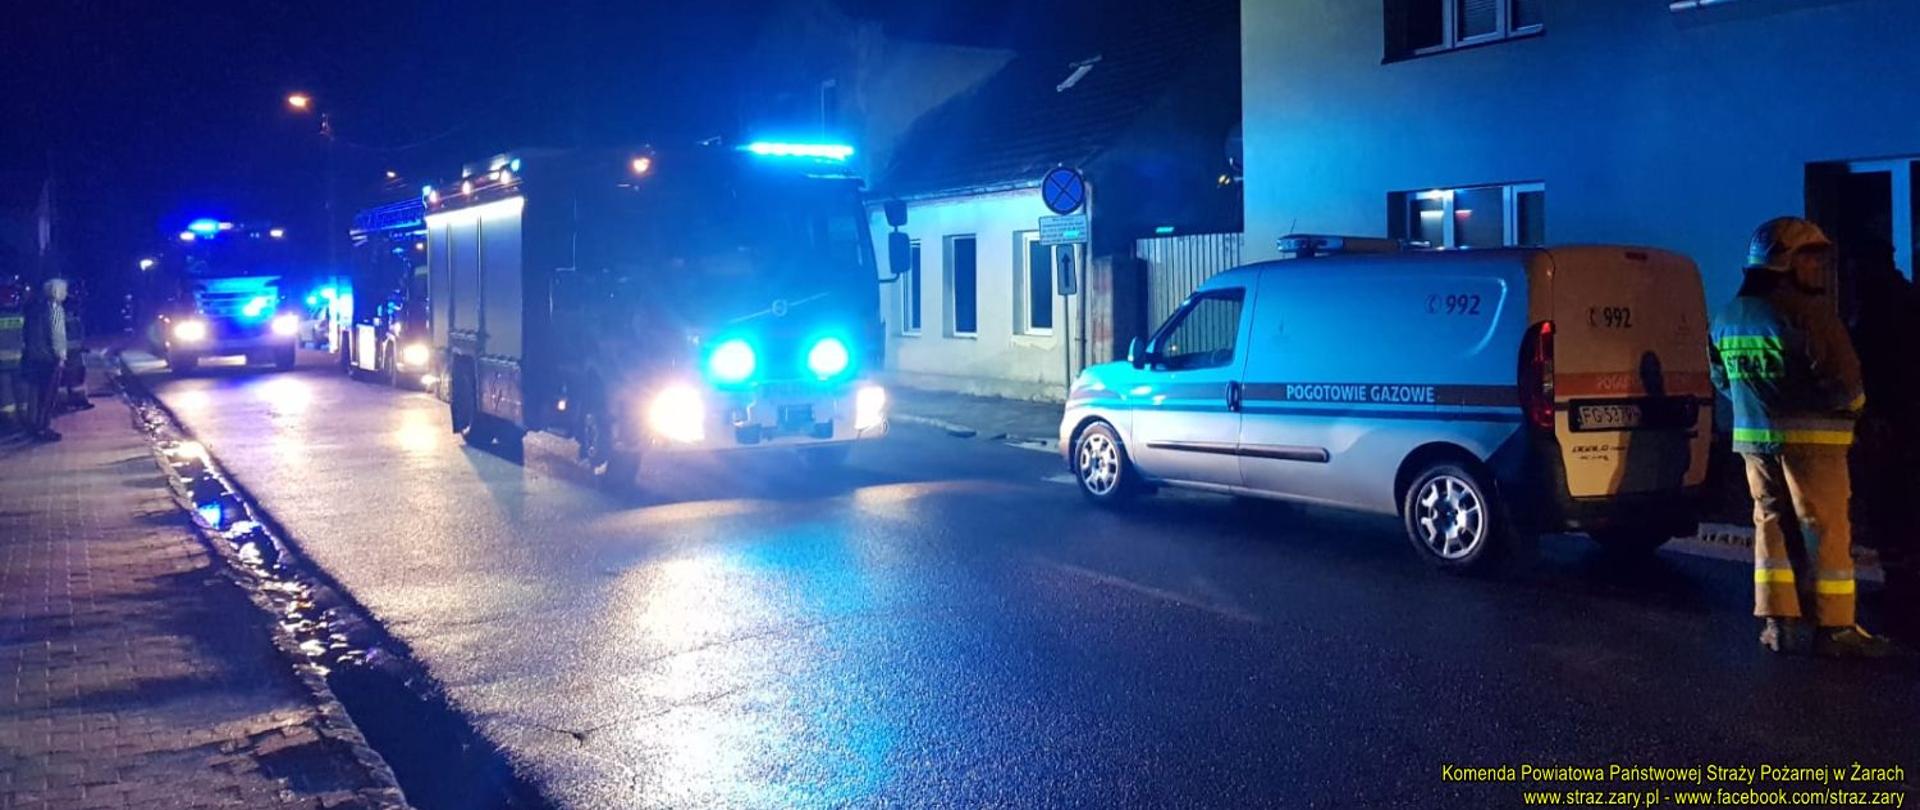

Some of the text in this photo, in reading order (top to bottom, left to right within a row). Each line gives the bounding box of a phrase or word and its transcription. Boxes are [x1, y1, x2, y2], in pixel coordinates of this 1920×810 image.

[1445, 294, 1481, 316] 992
[1603, 307, 1633, 328] 992
[1286, 384, 1436, 404] POGOTOWIE GAZOWE
